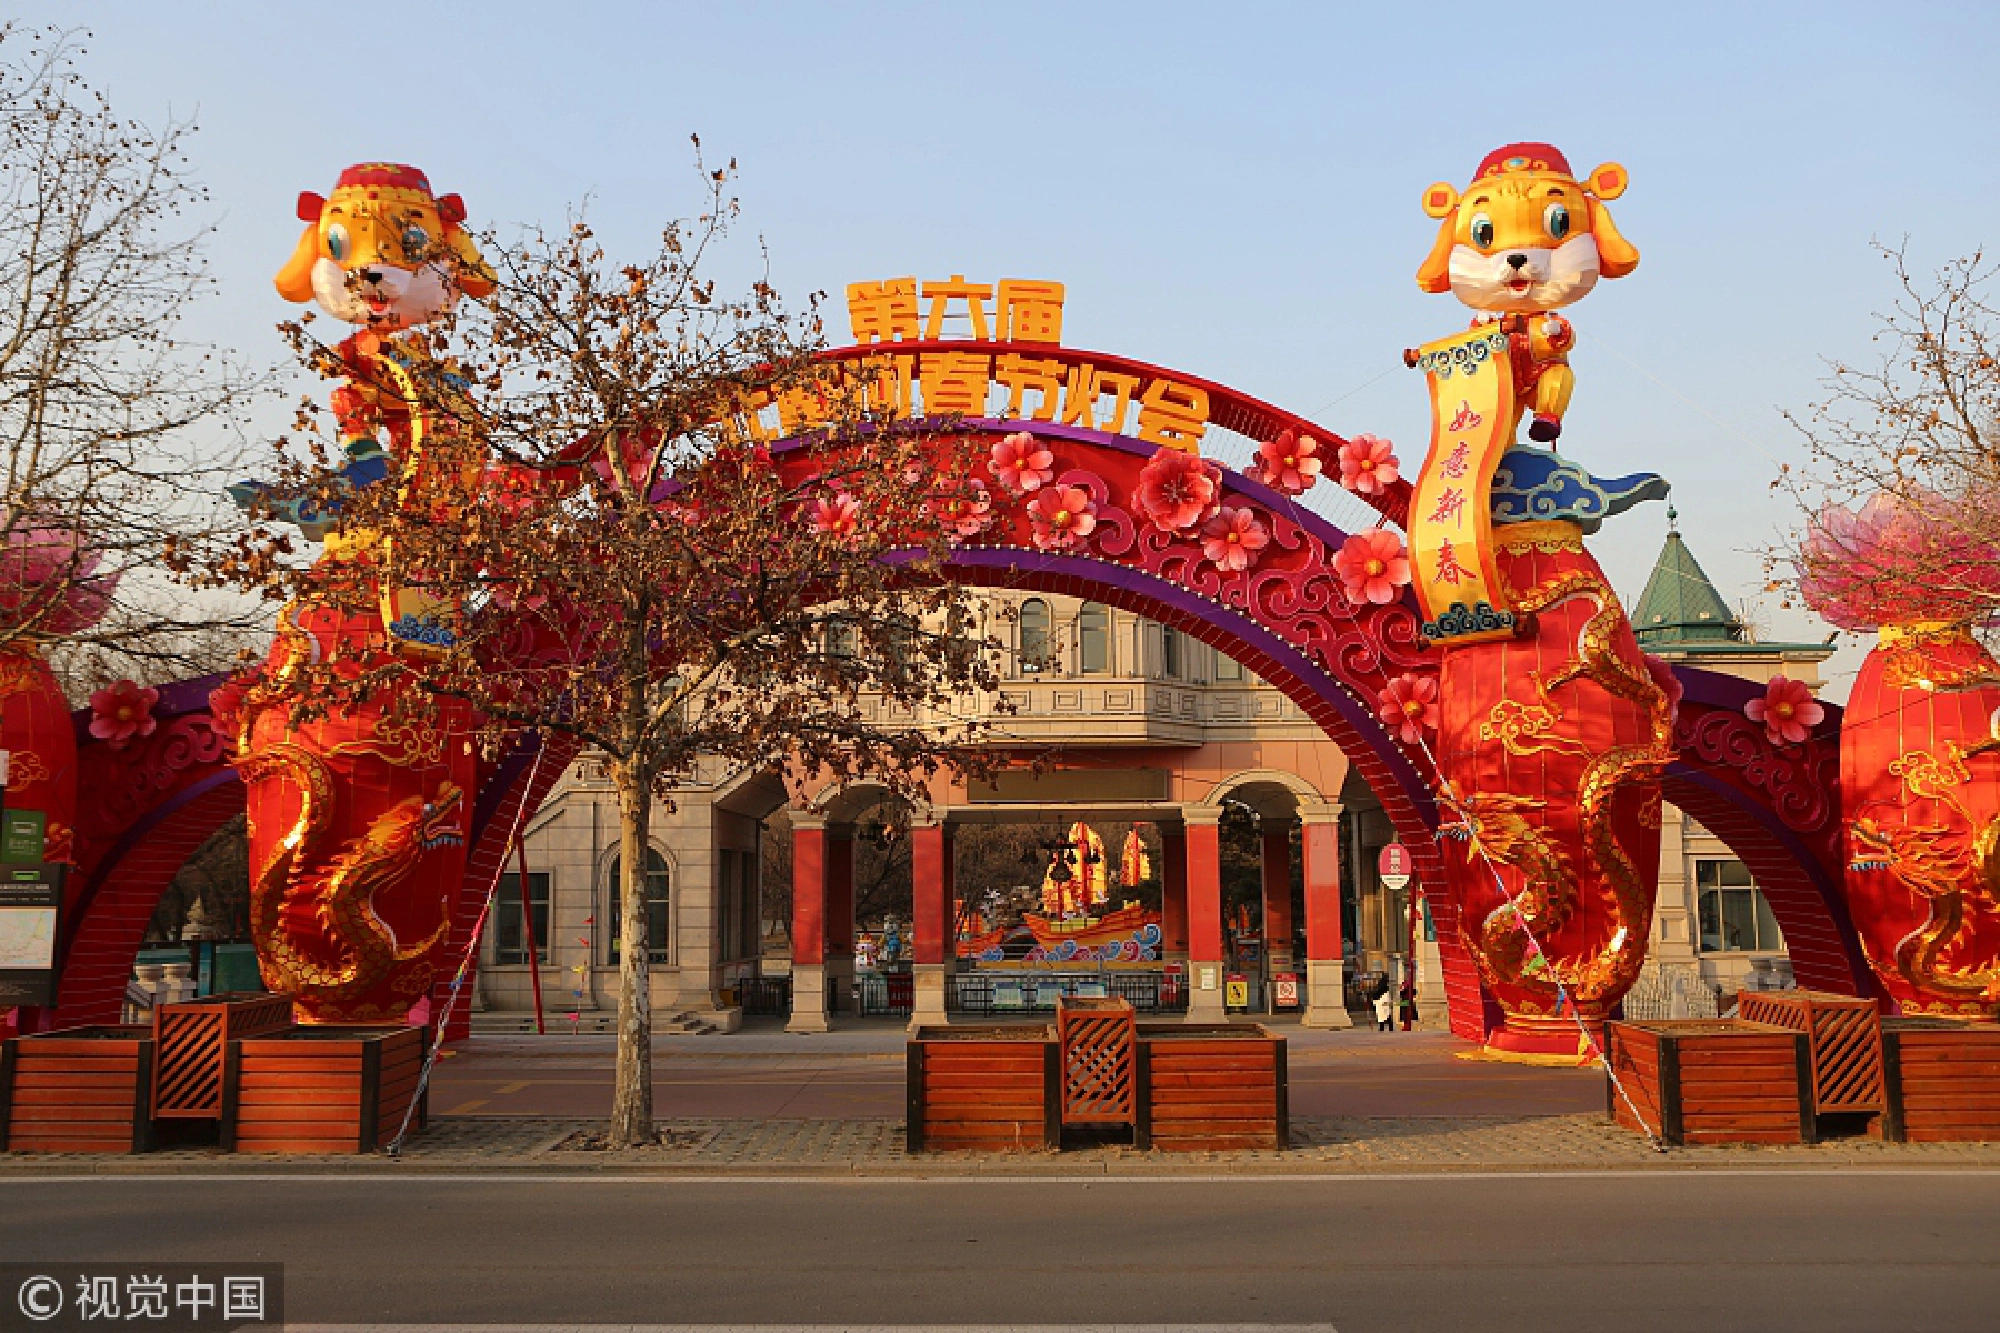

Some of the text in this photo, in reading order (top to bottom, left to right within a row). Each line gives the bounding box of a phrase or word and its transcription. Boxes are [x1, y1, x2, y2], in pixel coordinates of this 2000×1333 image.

[846, 275, 1065, 343] 第六届
[1427, 400, 1482, 584] 如意新春
